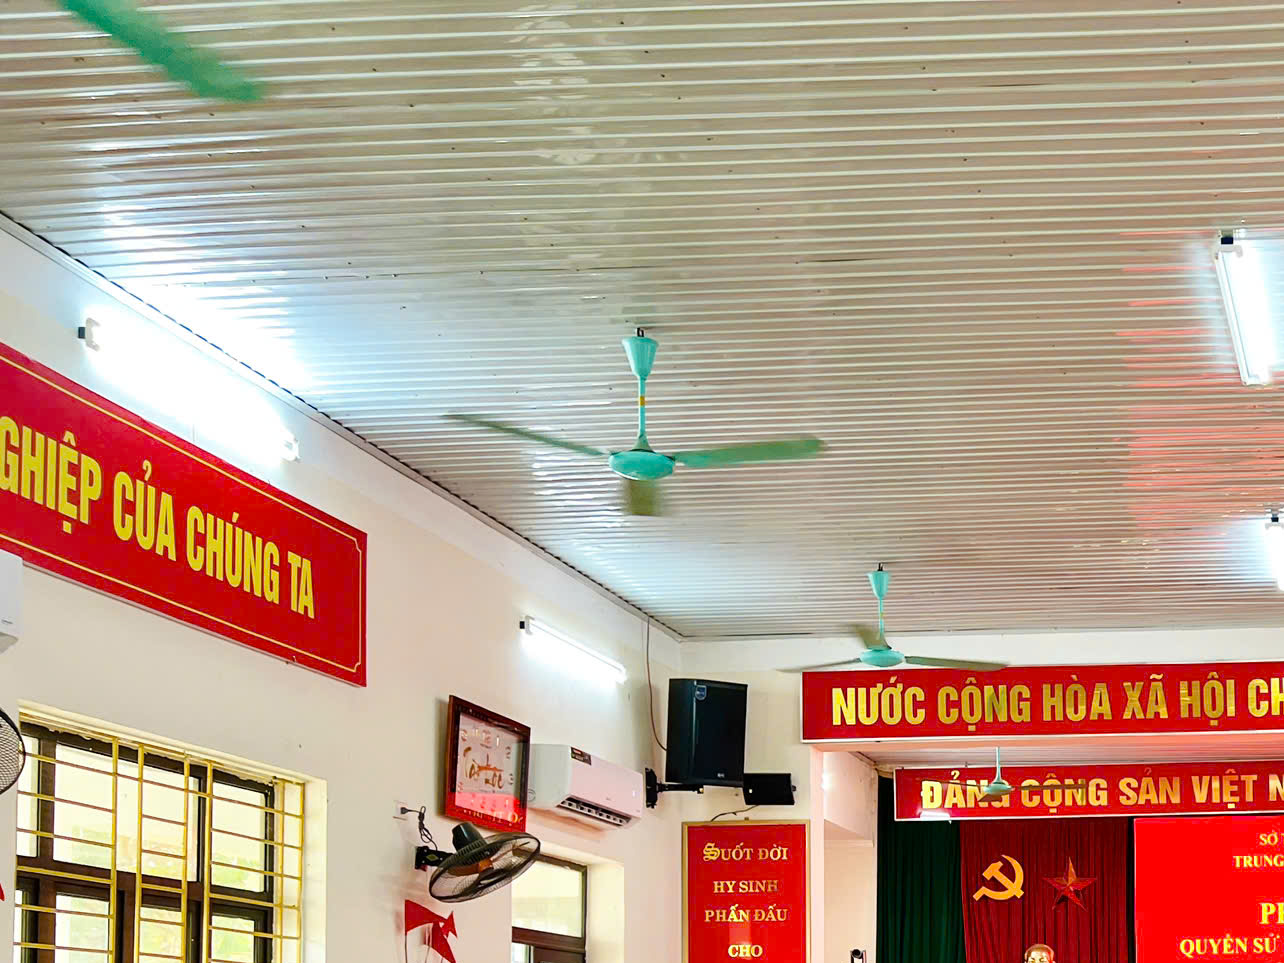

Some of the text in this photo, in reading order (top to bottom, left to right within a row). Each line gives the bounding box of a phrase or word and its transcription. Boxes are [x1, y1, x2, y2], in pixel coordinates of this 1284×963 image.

[113, 460, 176, 561] CỦA
[186, 505, 280, 604] CHÚNG
[288, 551, 314, 618] TA
[832, 676, 926, 726] NƯỚC
[937, 677, 1031, 731] CỘNG
[1043, 675, 1112, 721] HÒA
[1122, 674, 1168, 719] XÃ
[1179, 672, 1236, 726] HỘI
[1021, 773, 1108, 813] CỘNG
[1118, 767, 1181, 806] SẢN
[1191, 768, 1258, 808] VIỆT
[758, 844, 788, 861] ĐỜI
[1233, 855, 1284, 868] TRUNG
[713, 880, 778, 894] HY SINH
[704, 904, 750, 923] PHẤN
[727, 944, 763, 958] CHO
